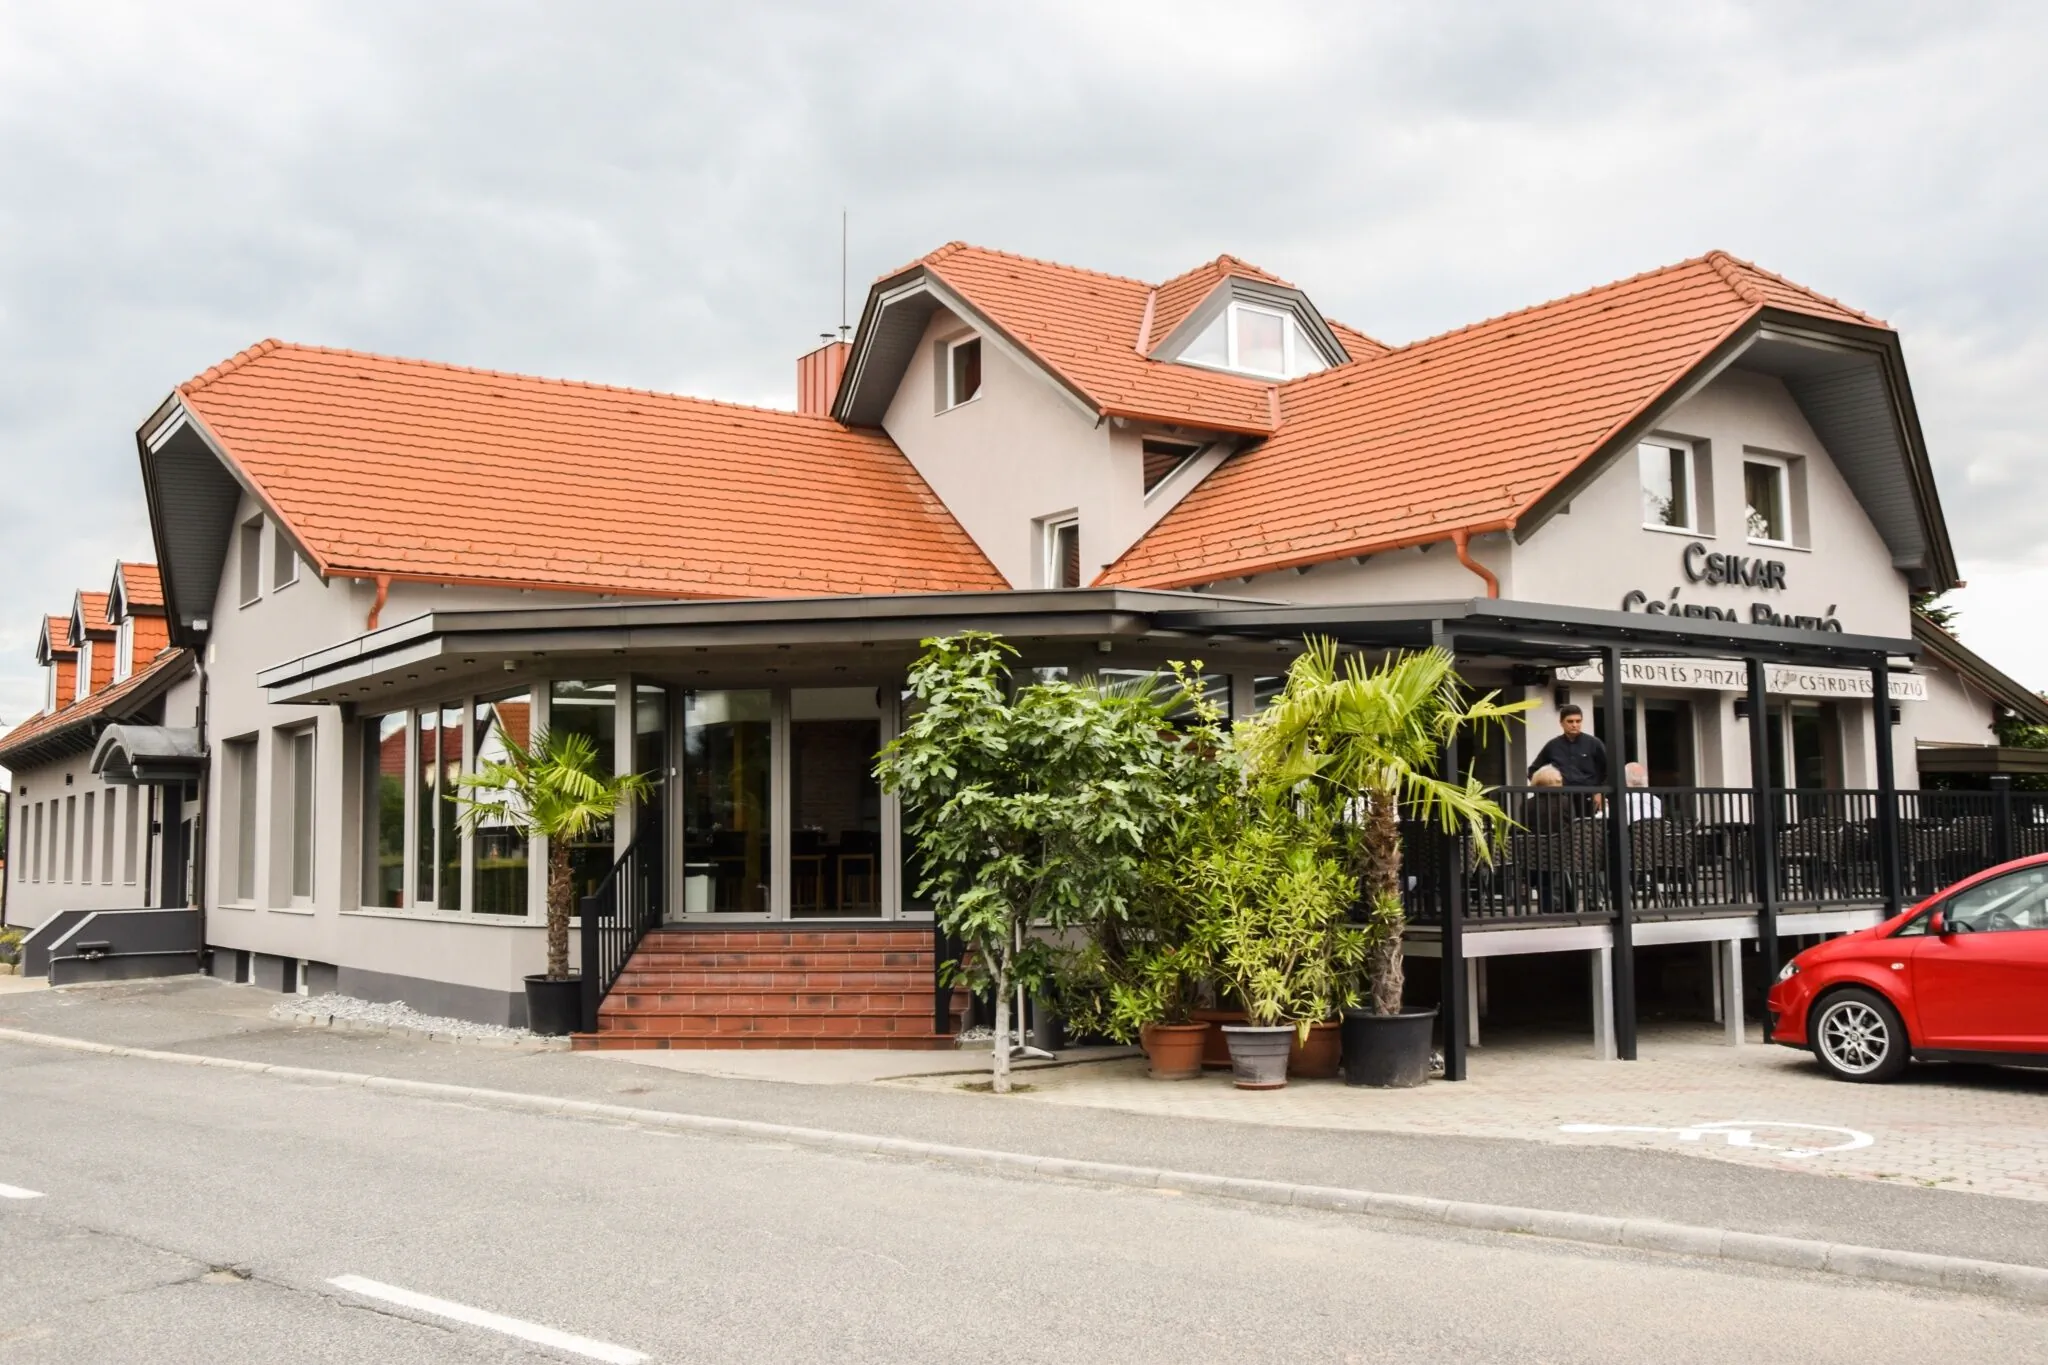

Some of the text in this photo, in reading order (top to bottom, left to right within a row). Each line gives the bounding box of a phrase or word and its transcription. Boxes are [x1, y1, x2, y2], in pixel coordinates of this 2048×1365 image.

[1683, 542, 1787, 590] CSIKAR
[1597, 659, 1668, 682] CÁRDA
[1800, 672, 1857, 692] CSÁRDA
[1887, 679, 1923, 697] ANZIÓ
